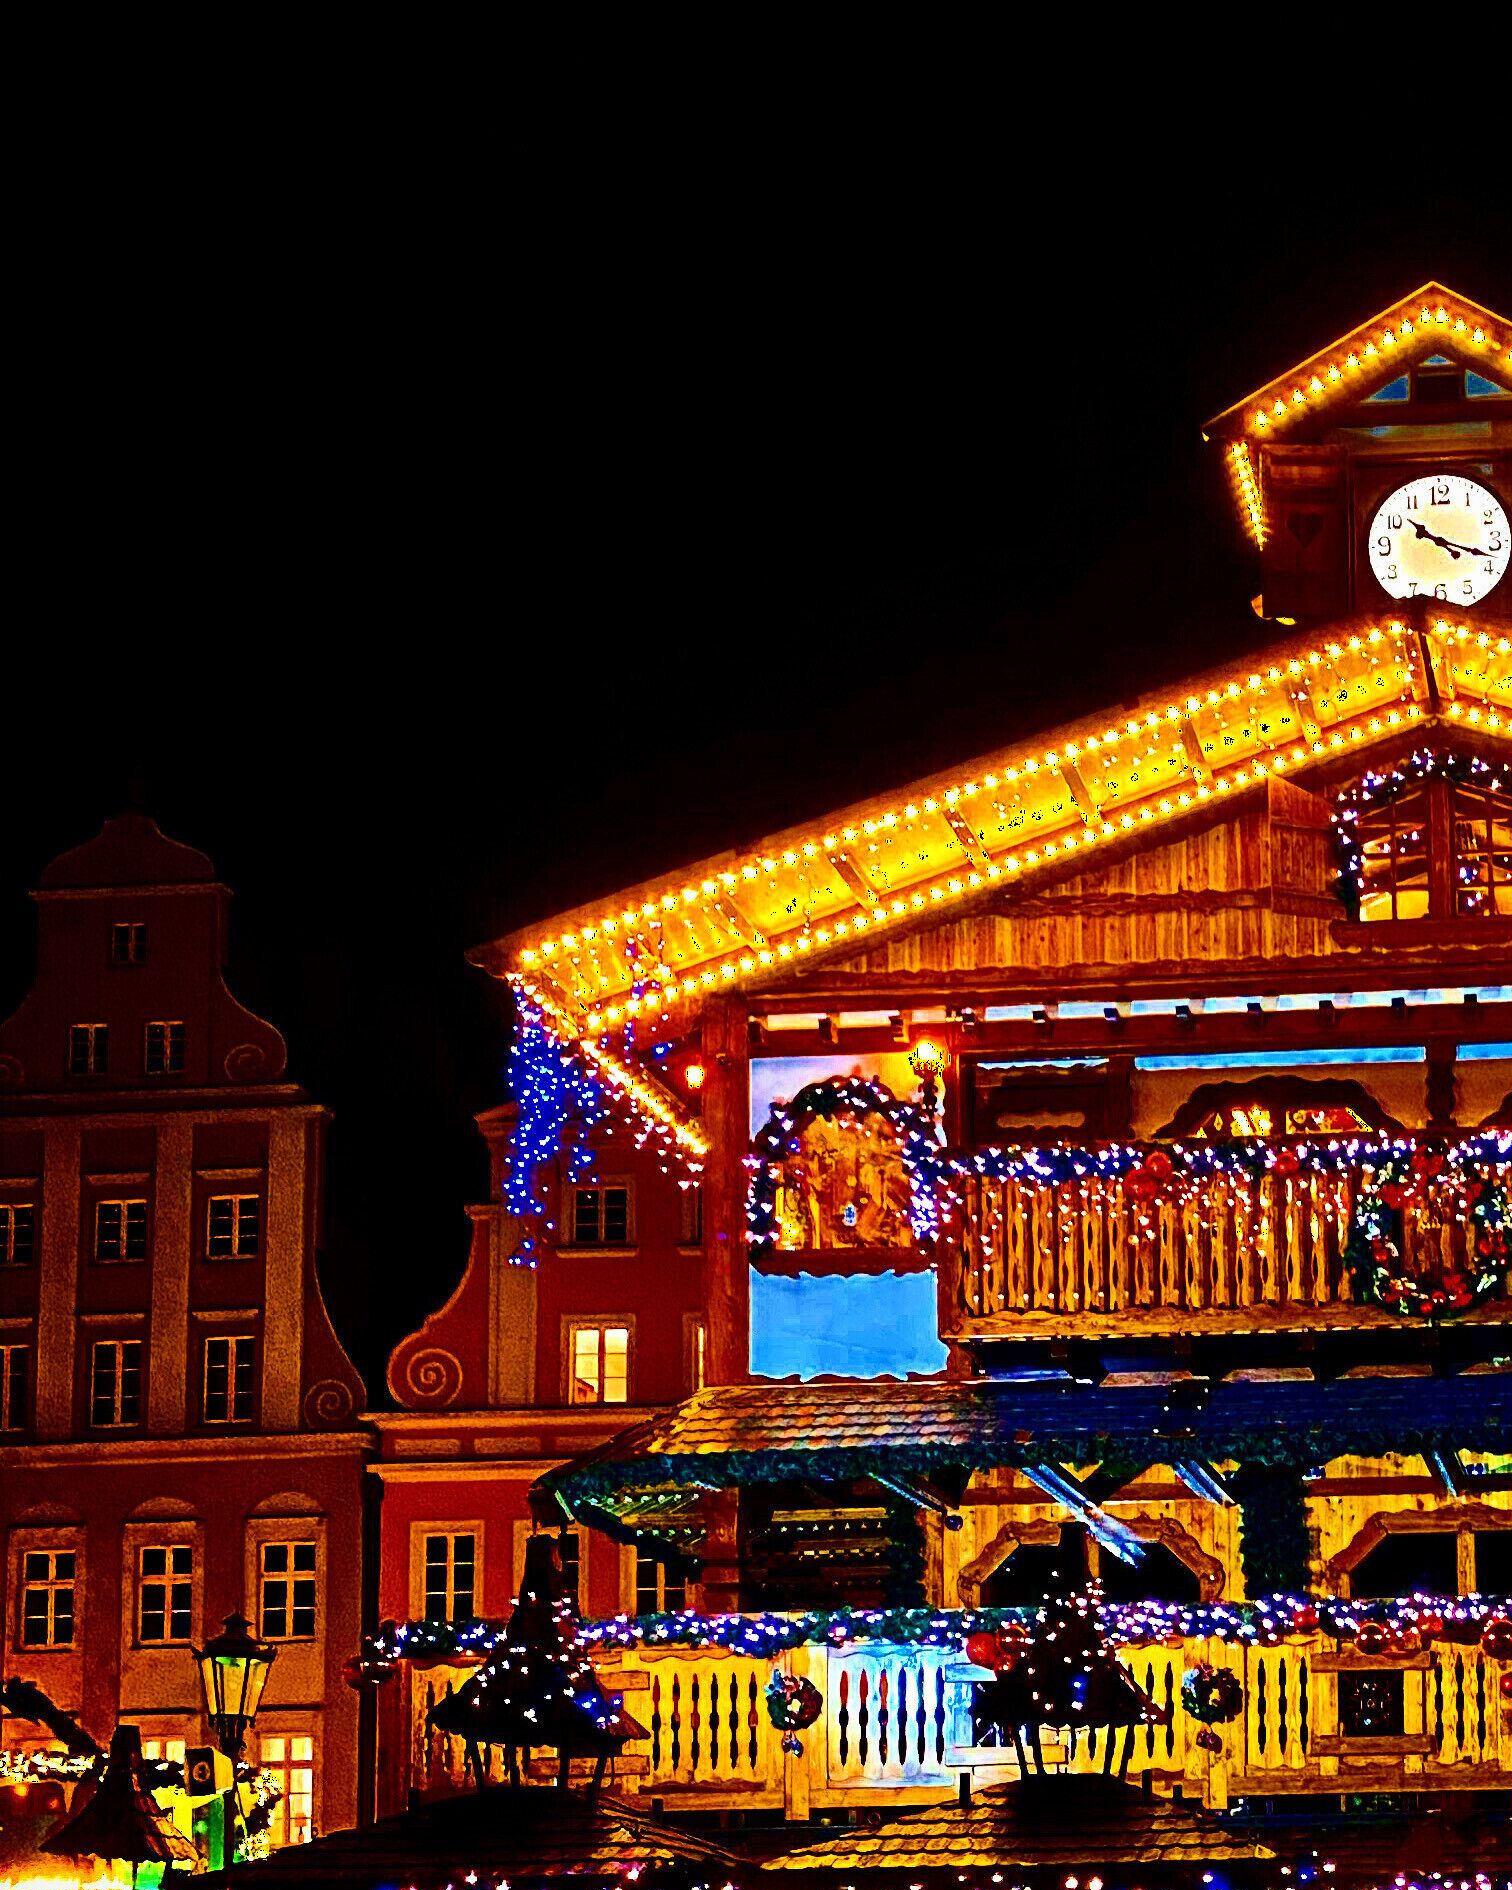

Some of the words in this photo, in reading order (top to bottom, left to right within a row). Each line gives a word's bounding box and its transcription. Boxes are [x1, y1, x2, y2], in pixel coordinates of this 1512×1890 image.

[1407, 495, 1419, 510] 11
[1429, 484, 1451, 506] 12
[1387, 514, 1403, 530] 10
[1377, 536, 1392, 557] 9
[1488, 530, 1502, 552] 3
[1483, 560, 1494, 575] 4
[1408, 582, 1419, 596] 7
[1434, 583, 1448, 601] 6
[1462, 579, 1473, 595] 5
